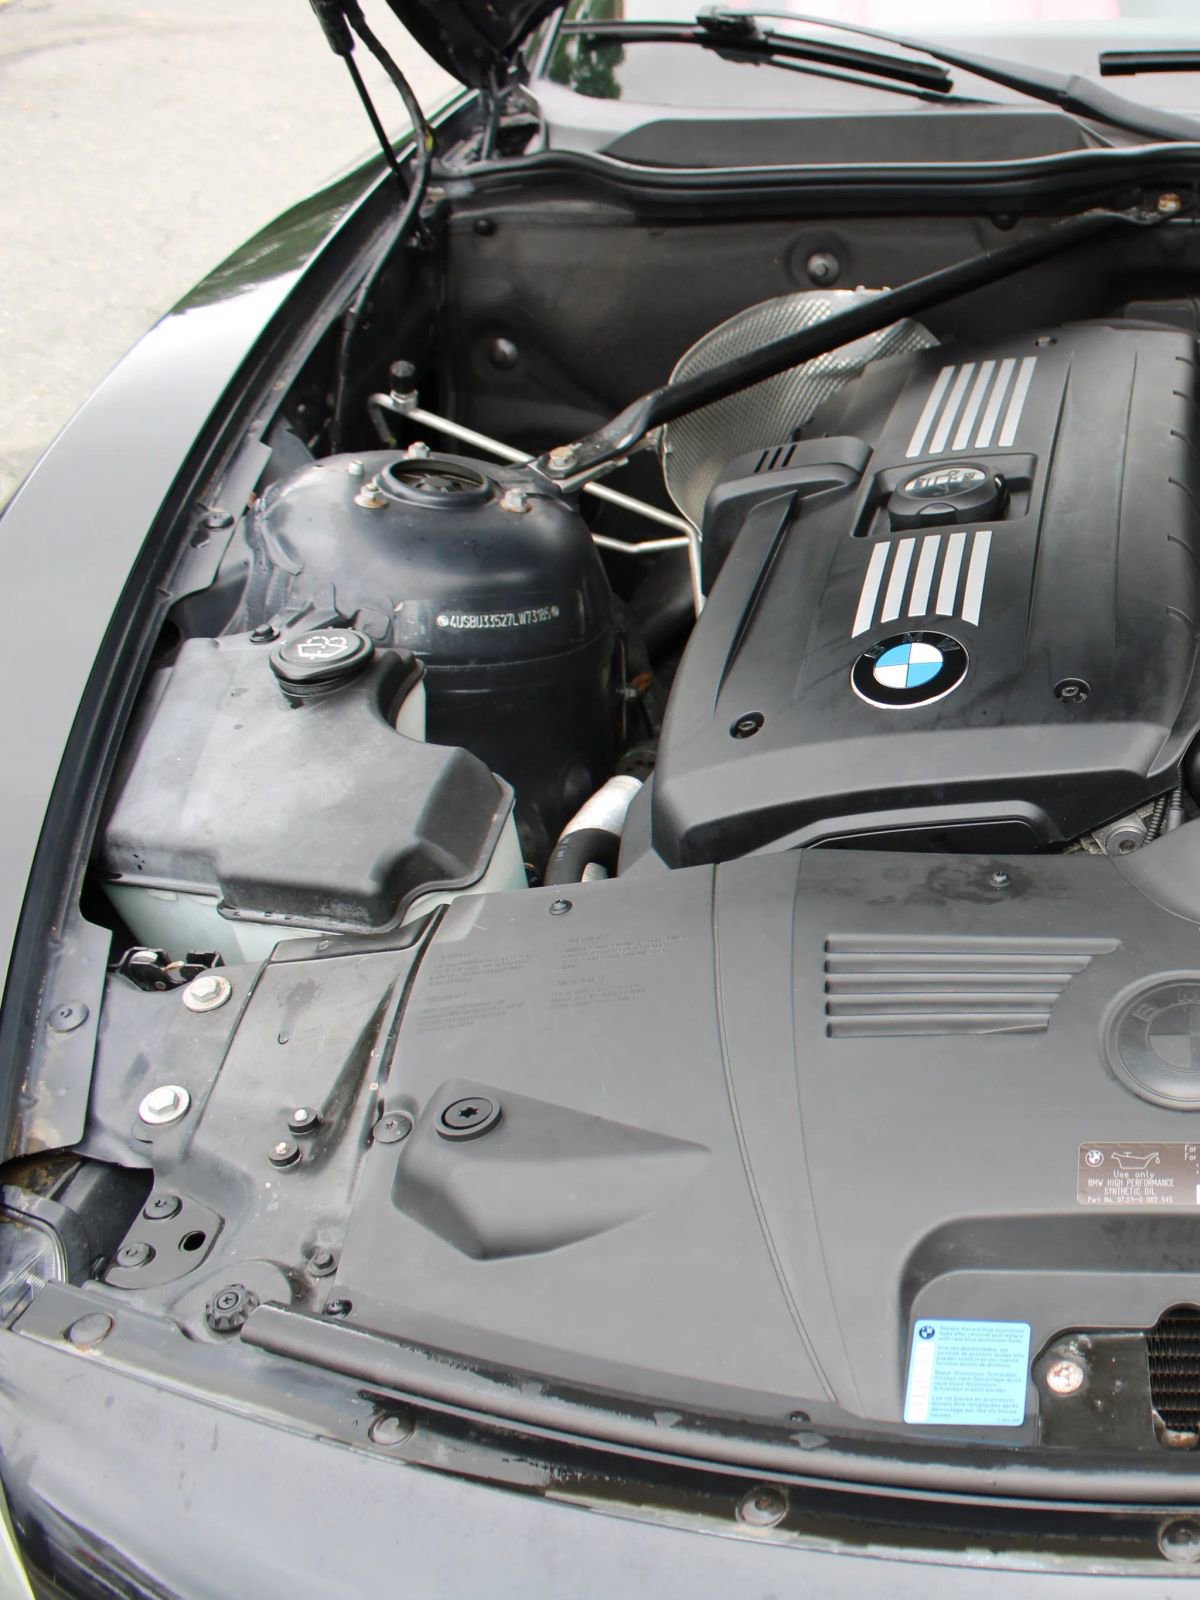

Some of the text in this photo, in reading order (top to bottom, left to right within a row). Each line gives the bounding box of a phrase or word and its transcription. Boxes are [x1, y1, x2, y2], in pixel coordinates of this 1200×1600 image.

[1184, 1144, 1197, 1153] For
[1184, 1153, 1197, 1161] For
[1113, 1169, 1155, 1180] Use only
[1087, 1178, 1175, 1188] BMW HIGH PERFORMANCE
[1103, 1187, 1156, 1196] SYNTHETIC OIL
